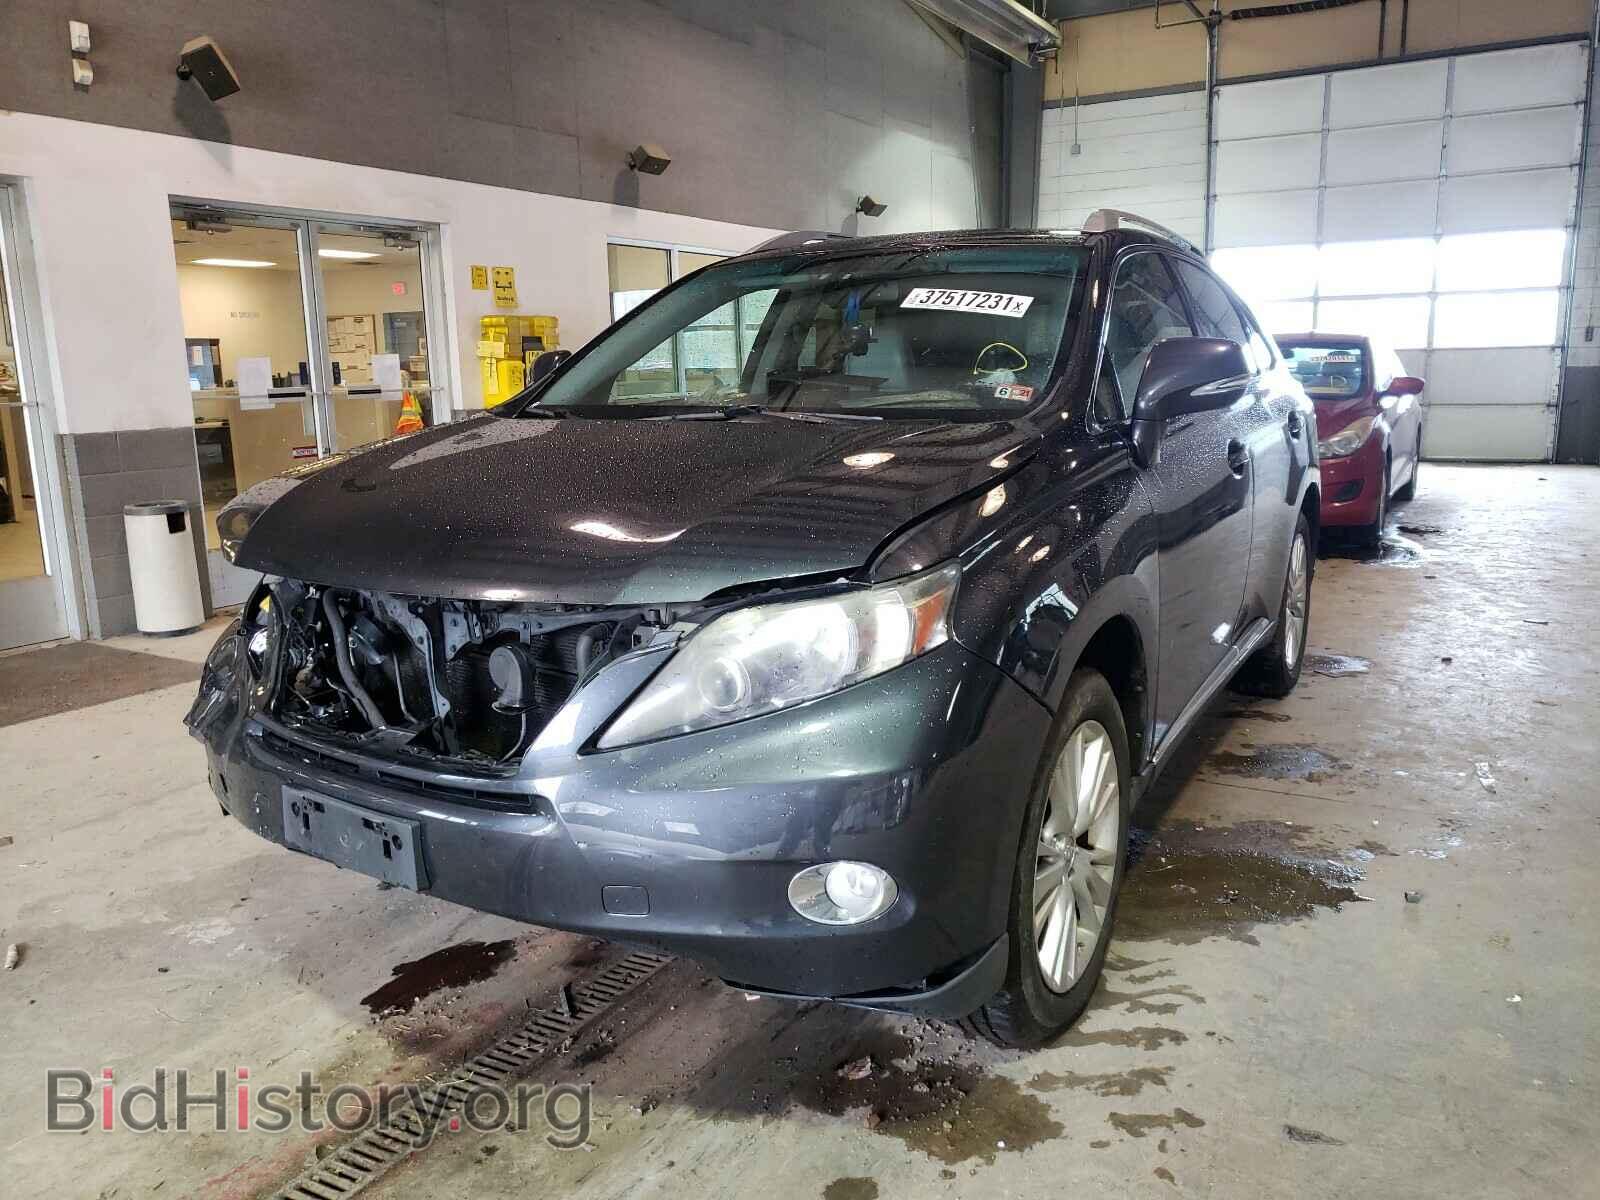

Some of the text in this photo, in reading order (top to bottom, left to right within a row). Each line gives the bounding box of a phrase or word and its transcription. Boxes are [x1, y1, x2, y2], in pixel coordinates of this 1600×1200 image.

[920, 290, 1014, 310] 37517231
[999, 387, 1031, 398] 6 21
